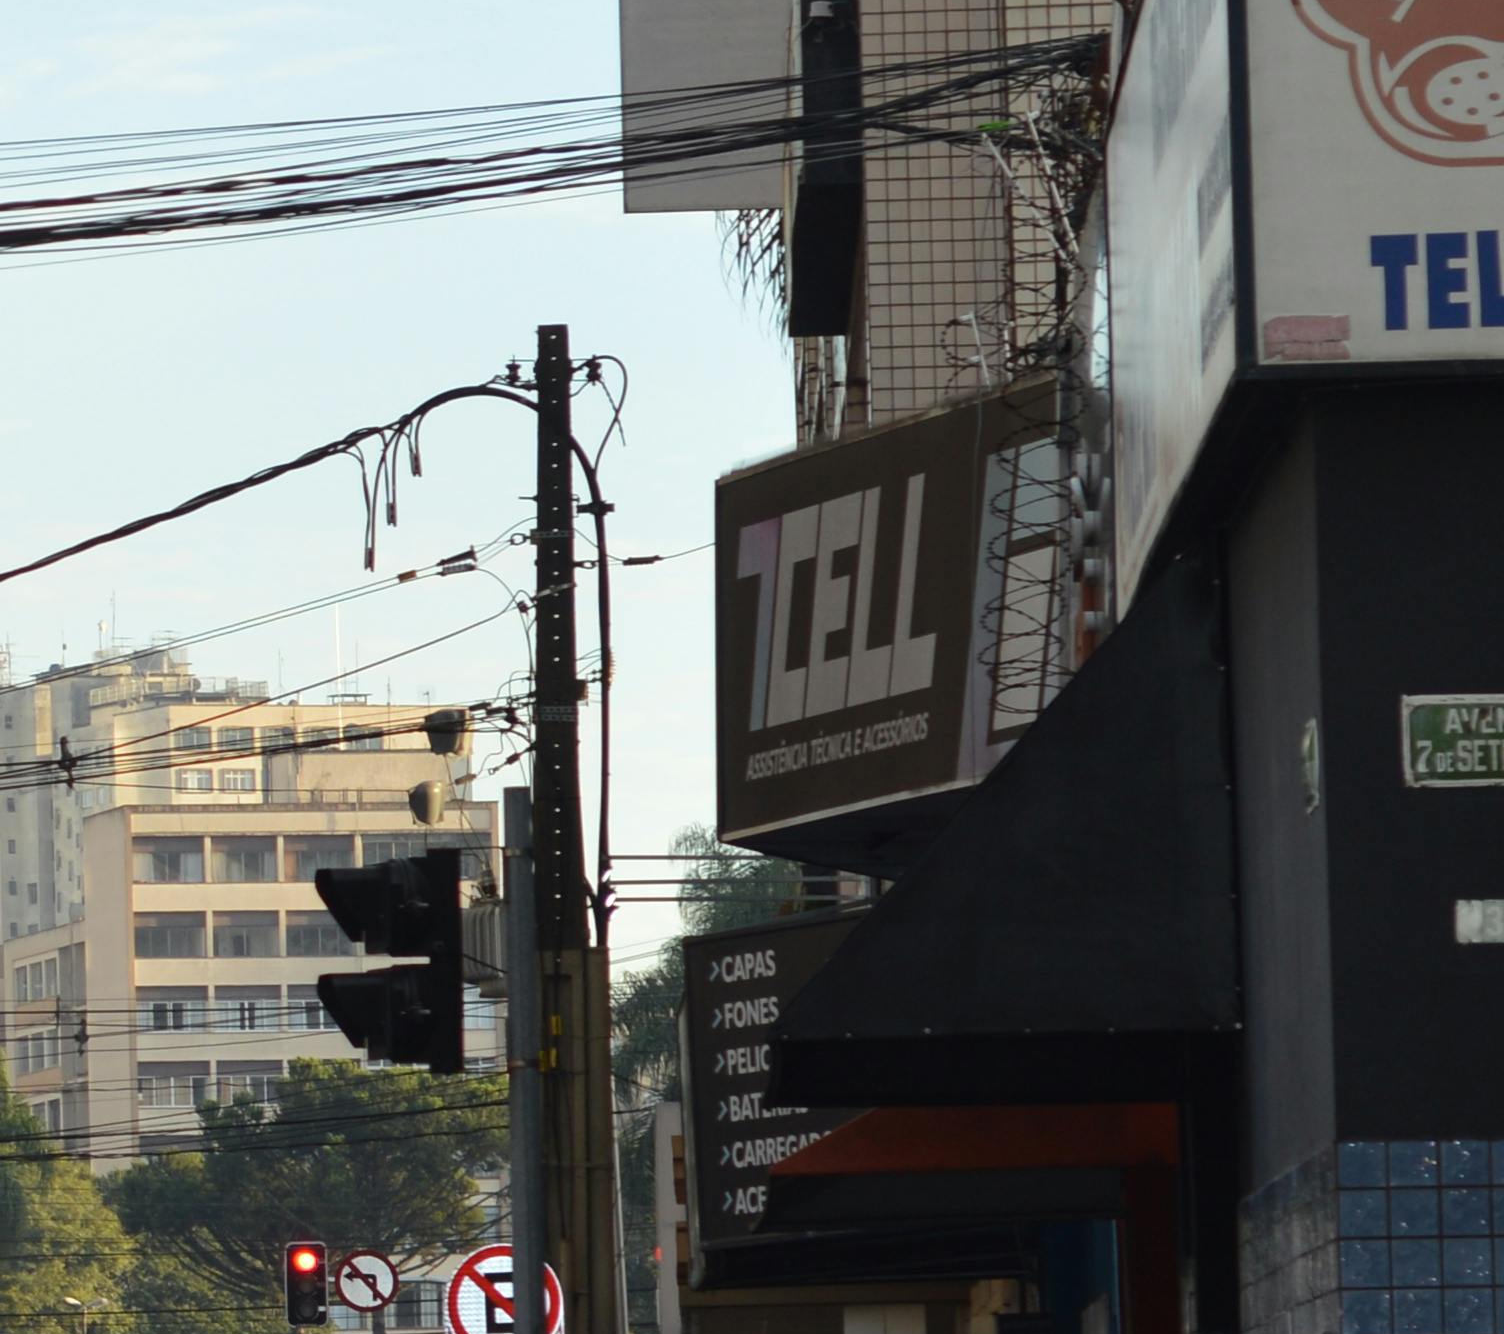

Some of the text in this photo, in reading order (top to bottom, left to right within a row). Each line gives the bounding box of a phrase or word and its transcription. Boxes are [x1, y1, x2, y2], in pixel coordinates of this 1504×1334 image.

[746, 710, 930, 781] ASSISTÊNCIA TÉCNICA E ACESSÓRIOS
[1416, 740, 1504, 773] 7 DE SET
[721, 950, 776, 983] CAPAS
[724, 997, 779, 1029] FONES
